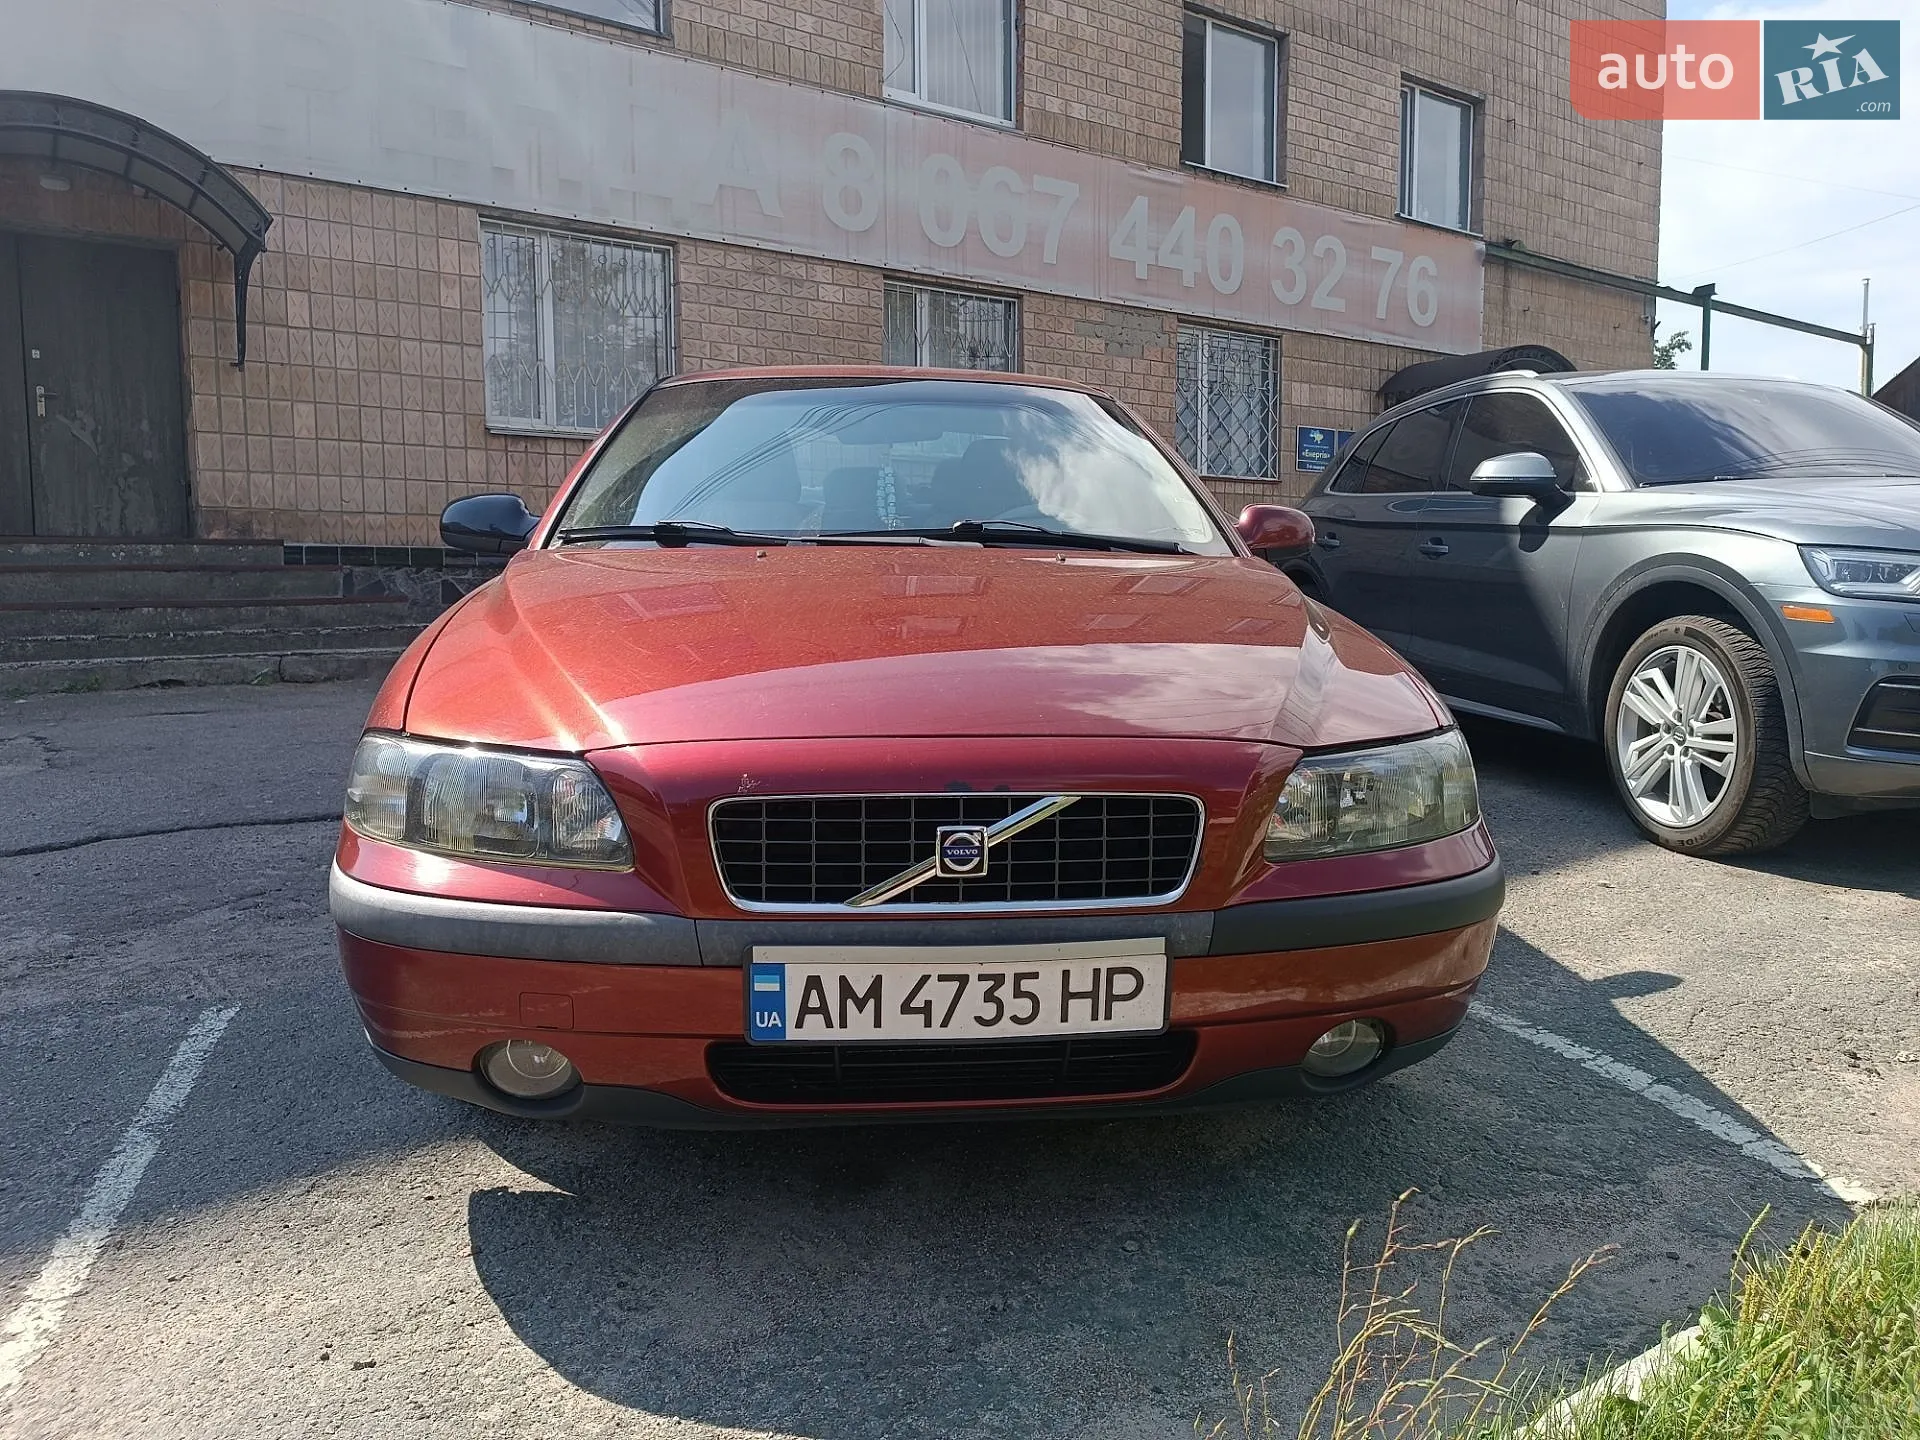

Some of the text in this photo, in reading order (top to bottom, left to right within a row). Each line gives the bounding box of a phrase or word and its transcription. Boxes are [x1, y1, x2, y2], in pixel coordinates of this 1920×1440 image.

[821, 131, 881, 232] 8
[917, 153, 1080, 264] 067
[1109, 195, 1245, 295] 440
[1270, 226, 1348, 312] 32
[1369, 245, 1439, 327] 76
[946, 848, 978, 856] VOLVO
[794, 965, 1145, 1030] AM 4735 HP
[756, 1012, 782, 1029] UA
